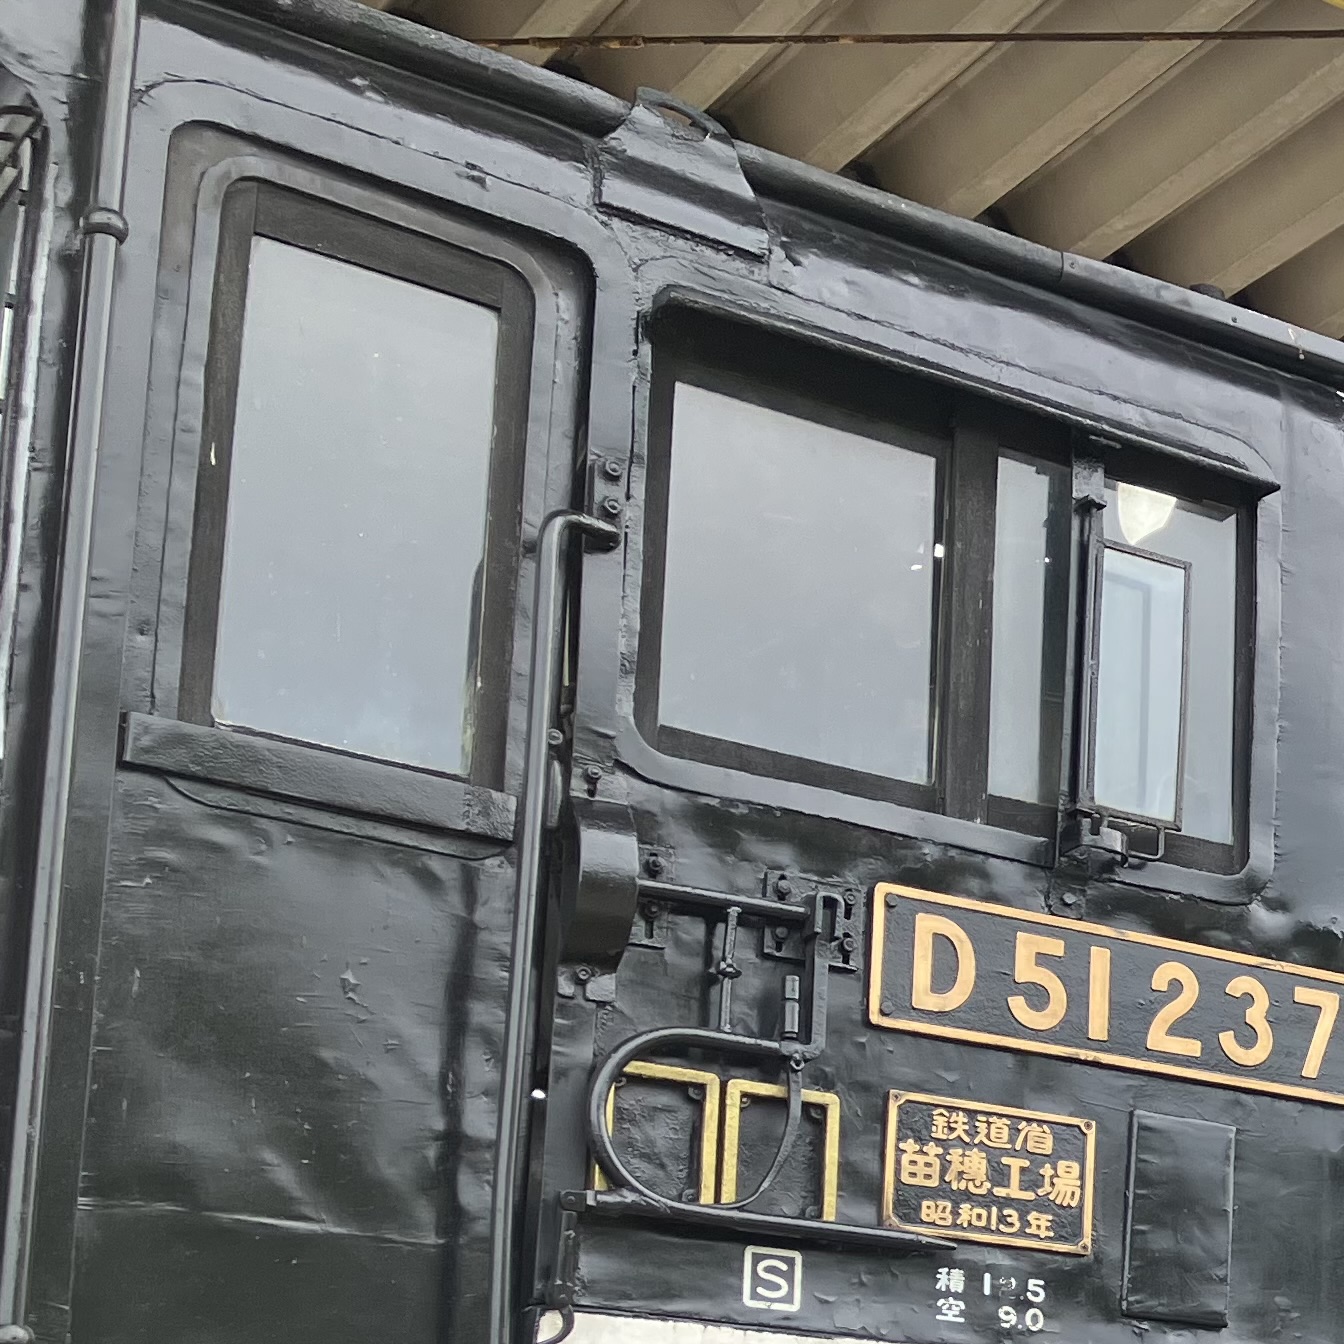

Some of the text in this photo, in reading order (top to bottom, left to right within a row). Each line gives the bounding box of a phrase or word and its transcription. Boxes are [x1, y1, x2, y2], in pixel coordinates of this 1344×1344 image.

[930, 1107, 1054, 1156] 鉄道省
[920, 1200, 1055, 1239] 昭和13年
[756, 1258, 789, 1299] S
[935, 1266, 966, 1294] 積
[935, 1296, 1045, 1332] 空 9.0
